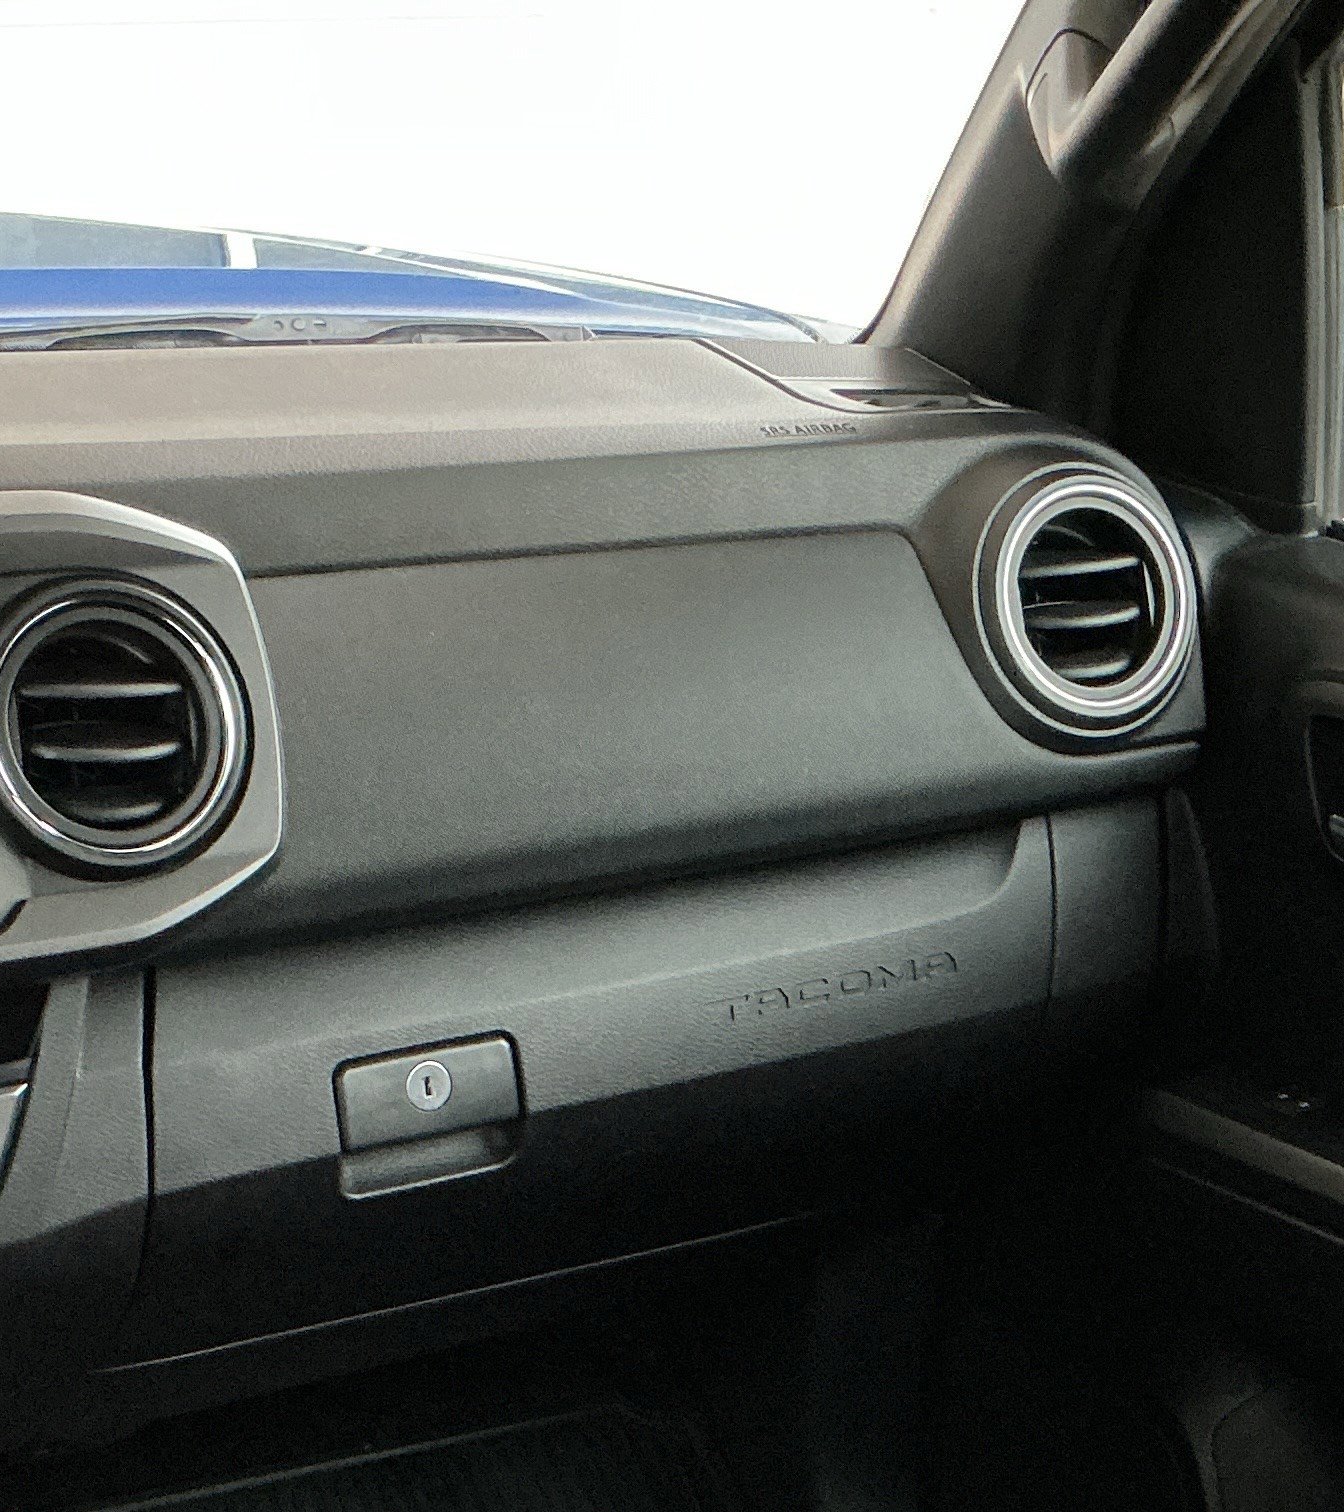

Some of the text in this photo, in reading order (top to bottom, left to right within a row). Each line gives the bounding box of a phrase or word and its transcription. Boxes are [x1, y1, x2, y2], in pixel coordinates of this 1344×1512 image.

[760, 422, 857, 437] SRS AIRBAG
[707, 950, 957, 1021] TACOMA
